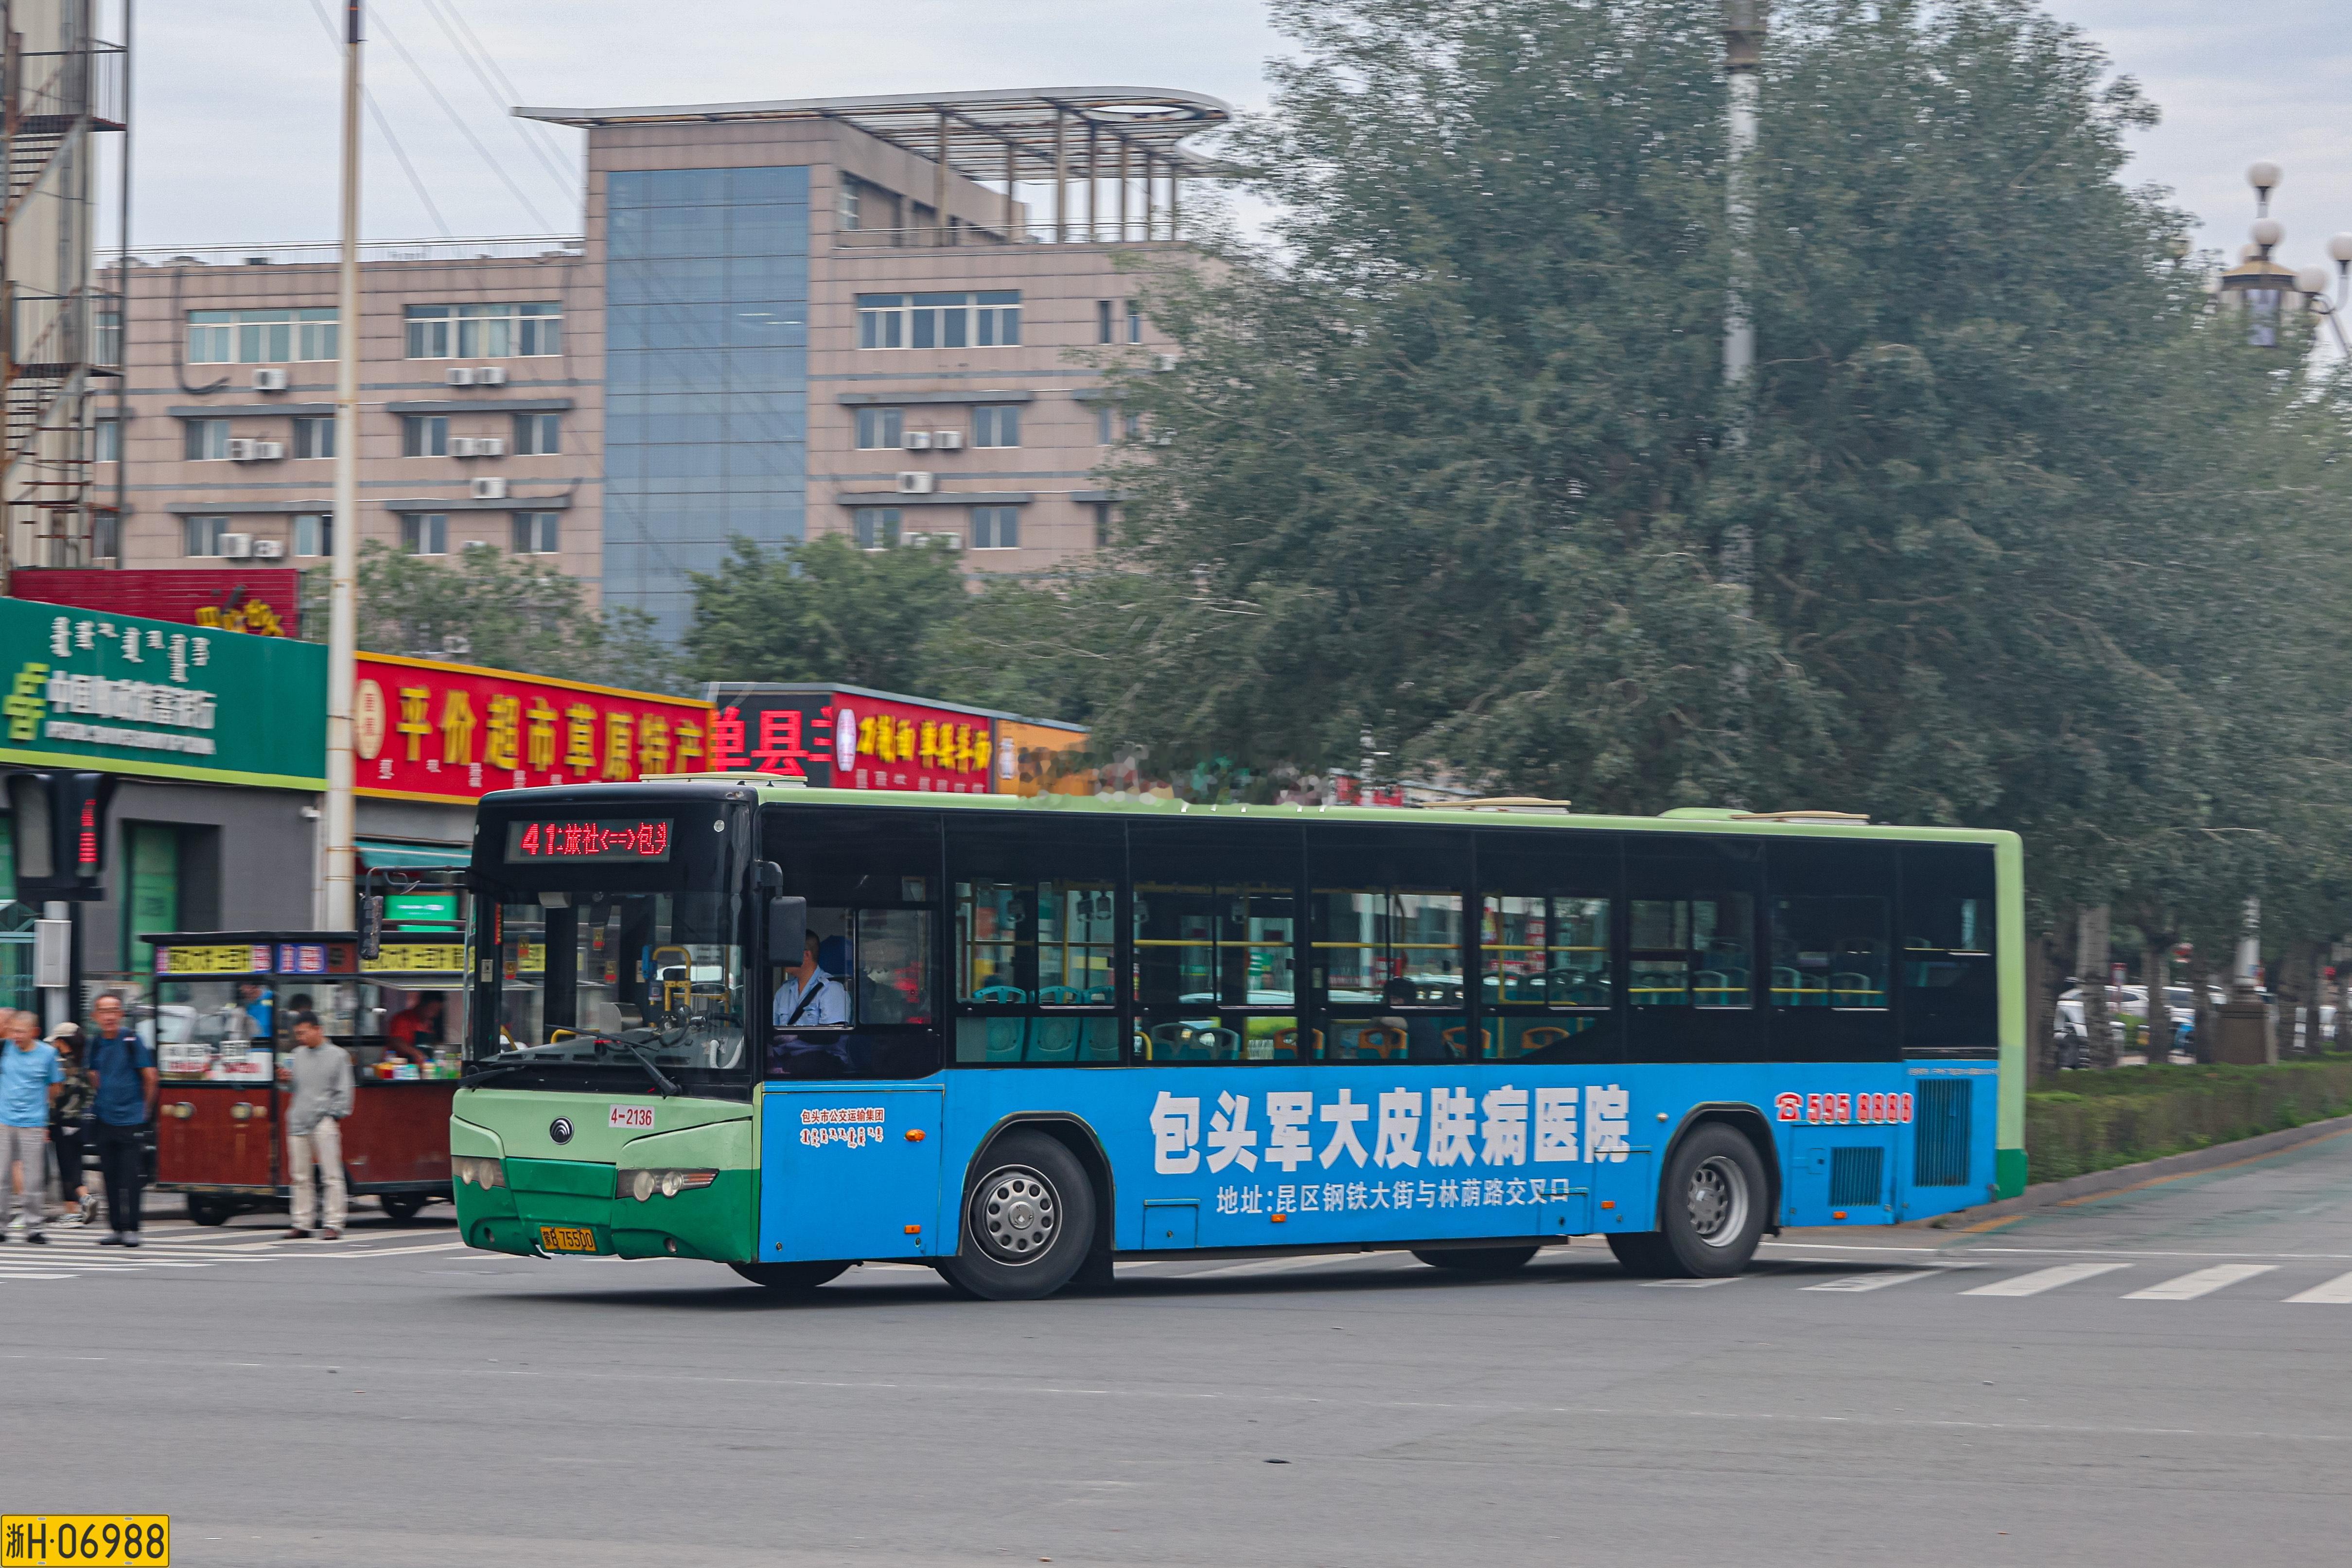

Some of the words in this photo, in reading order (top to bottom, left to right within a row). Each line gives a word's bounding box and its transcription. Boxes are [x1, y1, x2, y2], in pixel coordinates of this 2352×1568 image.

[396, 686, 704, 781] 平价超市草原特产
[611, 1108, 652, 1126] 4-2136
[801, 1108, 885, 1124] 包头市公交运输集团
[1149, 1084, 1629, 1174] 包头军大皮肤病医院
